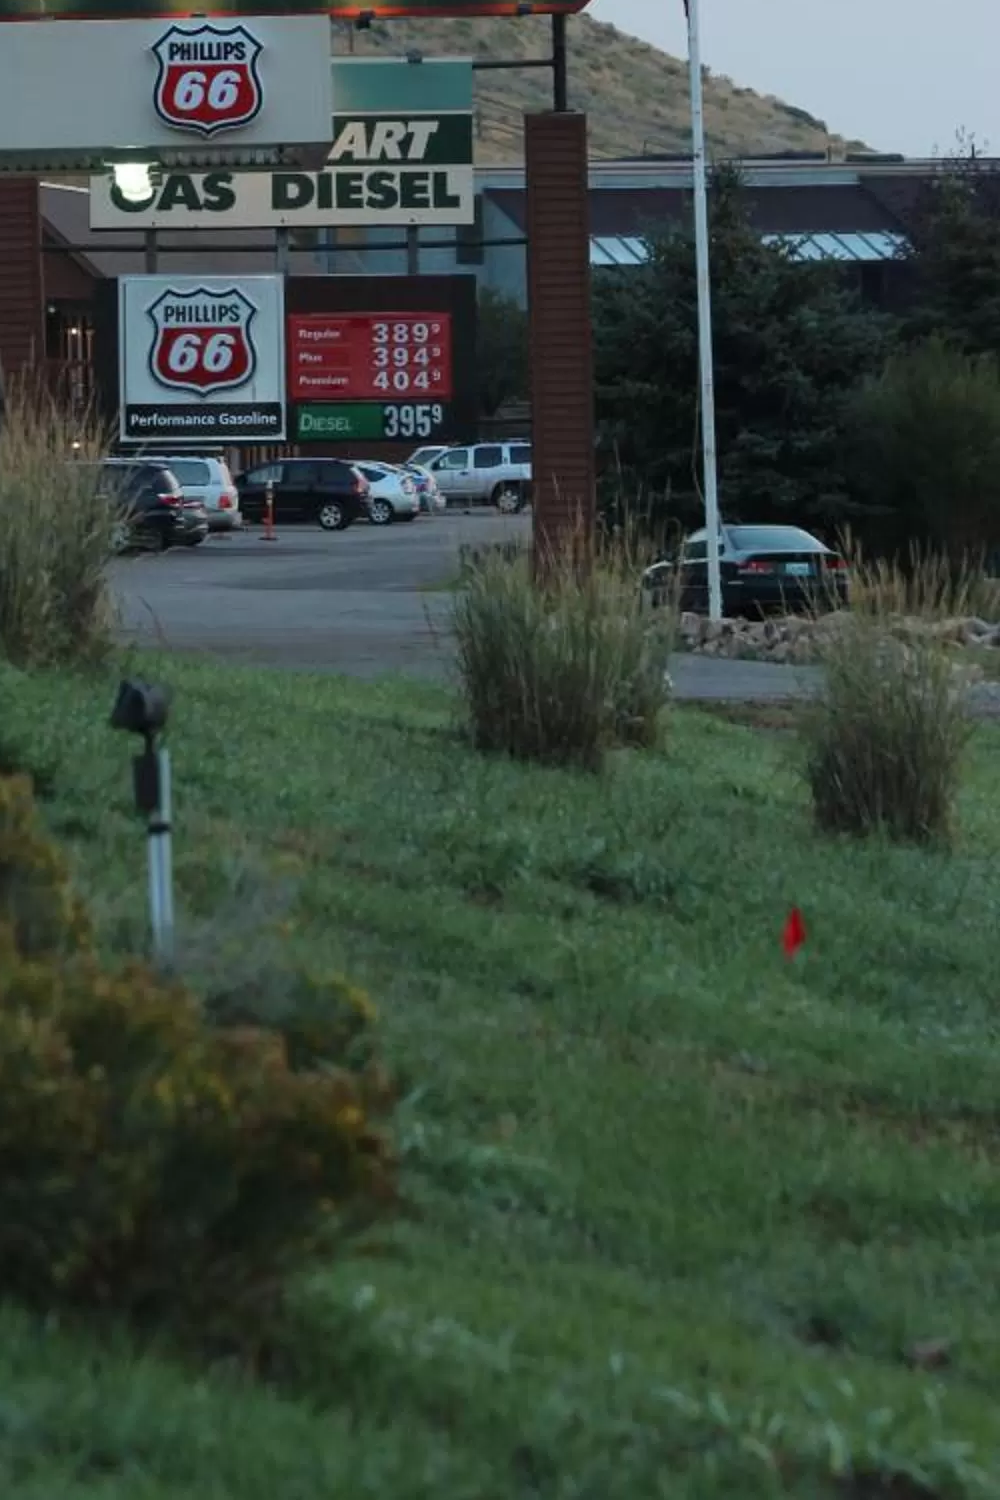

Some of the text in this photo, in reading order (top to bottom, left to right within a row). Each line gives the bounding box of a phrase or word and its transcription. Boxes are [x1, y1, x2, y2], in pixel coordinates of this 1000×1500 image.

[168, 41, 247, 61] PHILLIPS
[173, 70, 243, 111] 66
[271, 171, 461, 210] DIESEL
[163, 304, 241, 323] PHILLIPS
[167, 332, 237, 373] 66
[130, 412, 278, 427] Performance Gasoline
